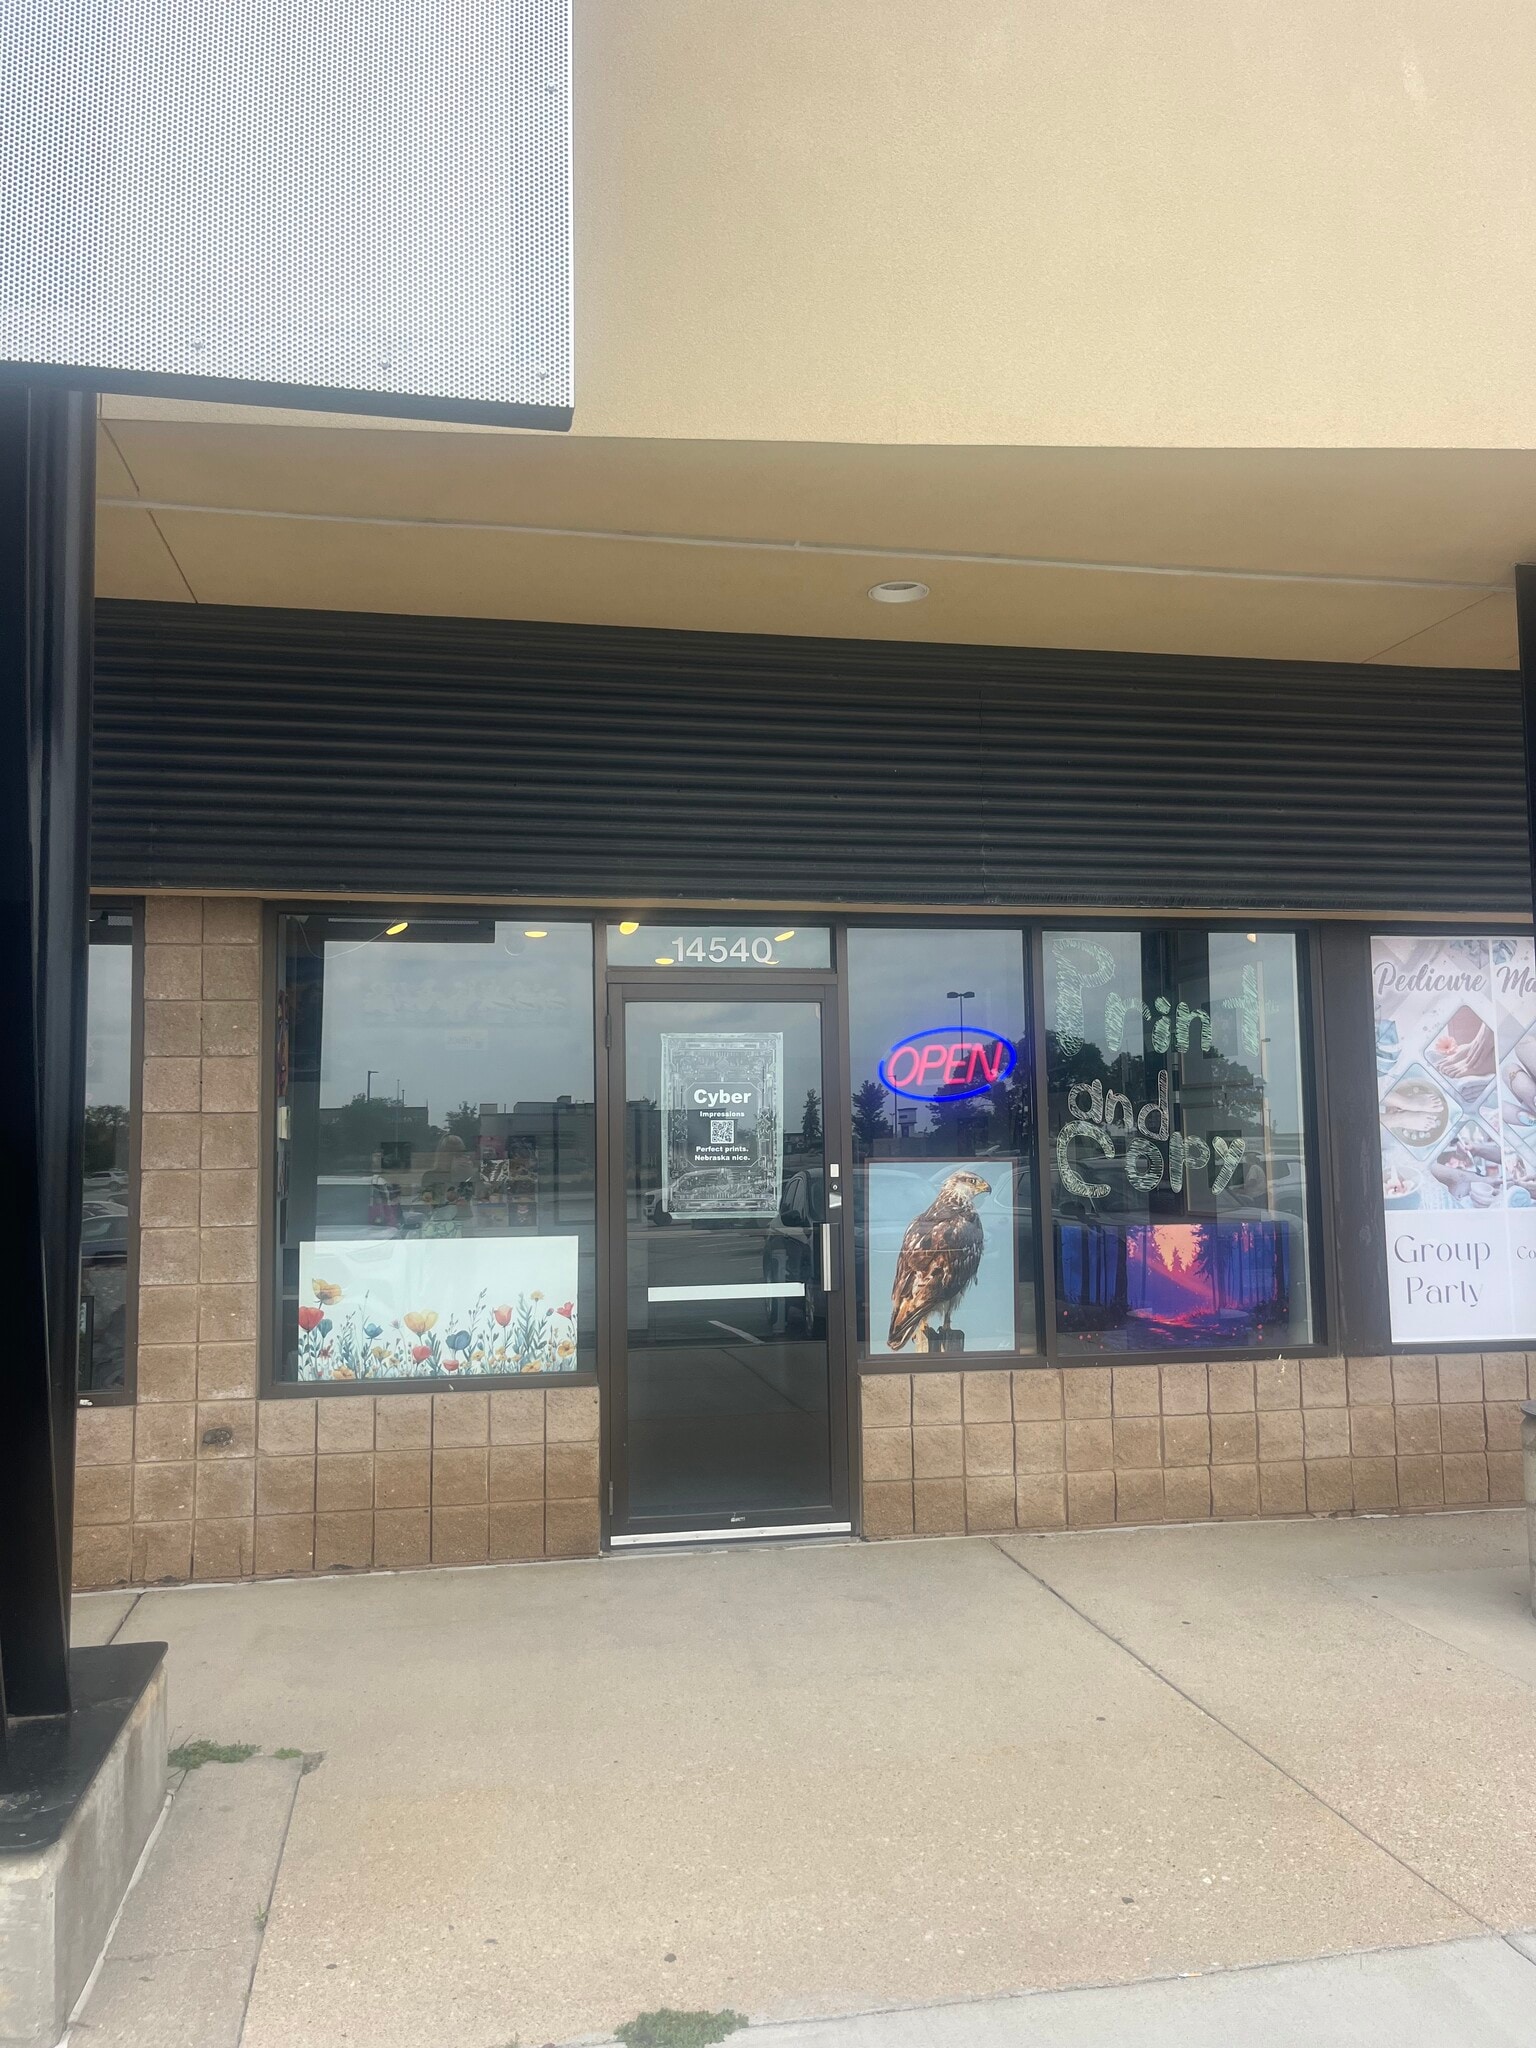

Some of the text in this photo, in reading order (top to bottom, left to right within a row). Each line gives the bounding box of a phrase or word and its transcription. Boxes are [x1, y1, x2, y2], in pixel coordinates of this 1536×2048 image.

[671, 936, 773, 963] 14540
[1373, 961, 1487, 995] Pedicure
[1052, 938, 1280, 1057] Print
[887, 1041, 1004, 1087] OPEN
[693, 1088, 752, 1108] Cyber
[699, 1110, 745, 1118] Impressions
[1067, 1069, 1169, 1141] and
[724, 1145, 749, 1153] prints.
[1056, 1119, 1246, 1198] Copy
[1394, 1234, 1491, 1270] Group
[1406, 1276, 1483, 1308] Party
